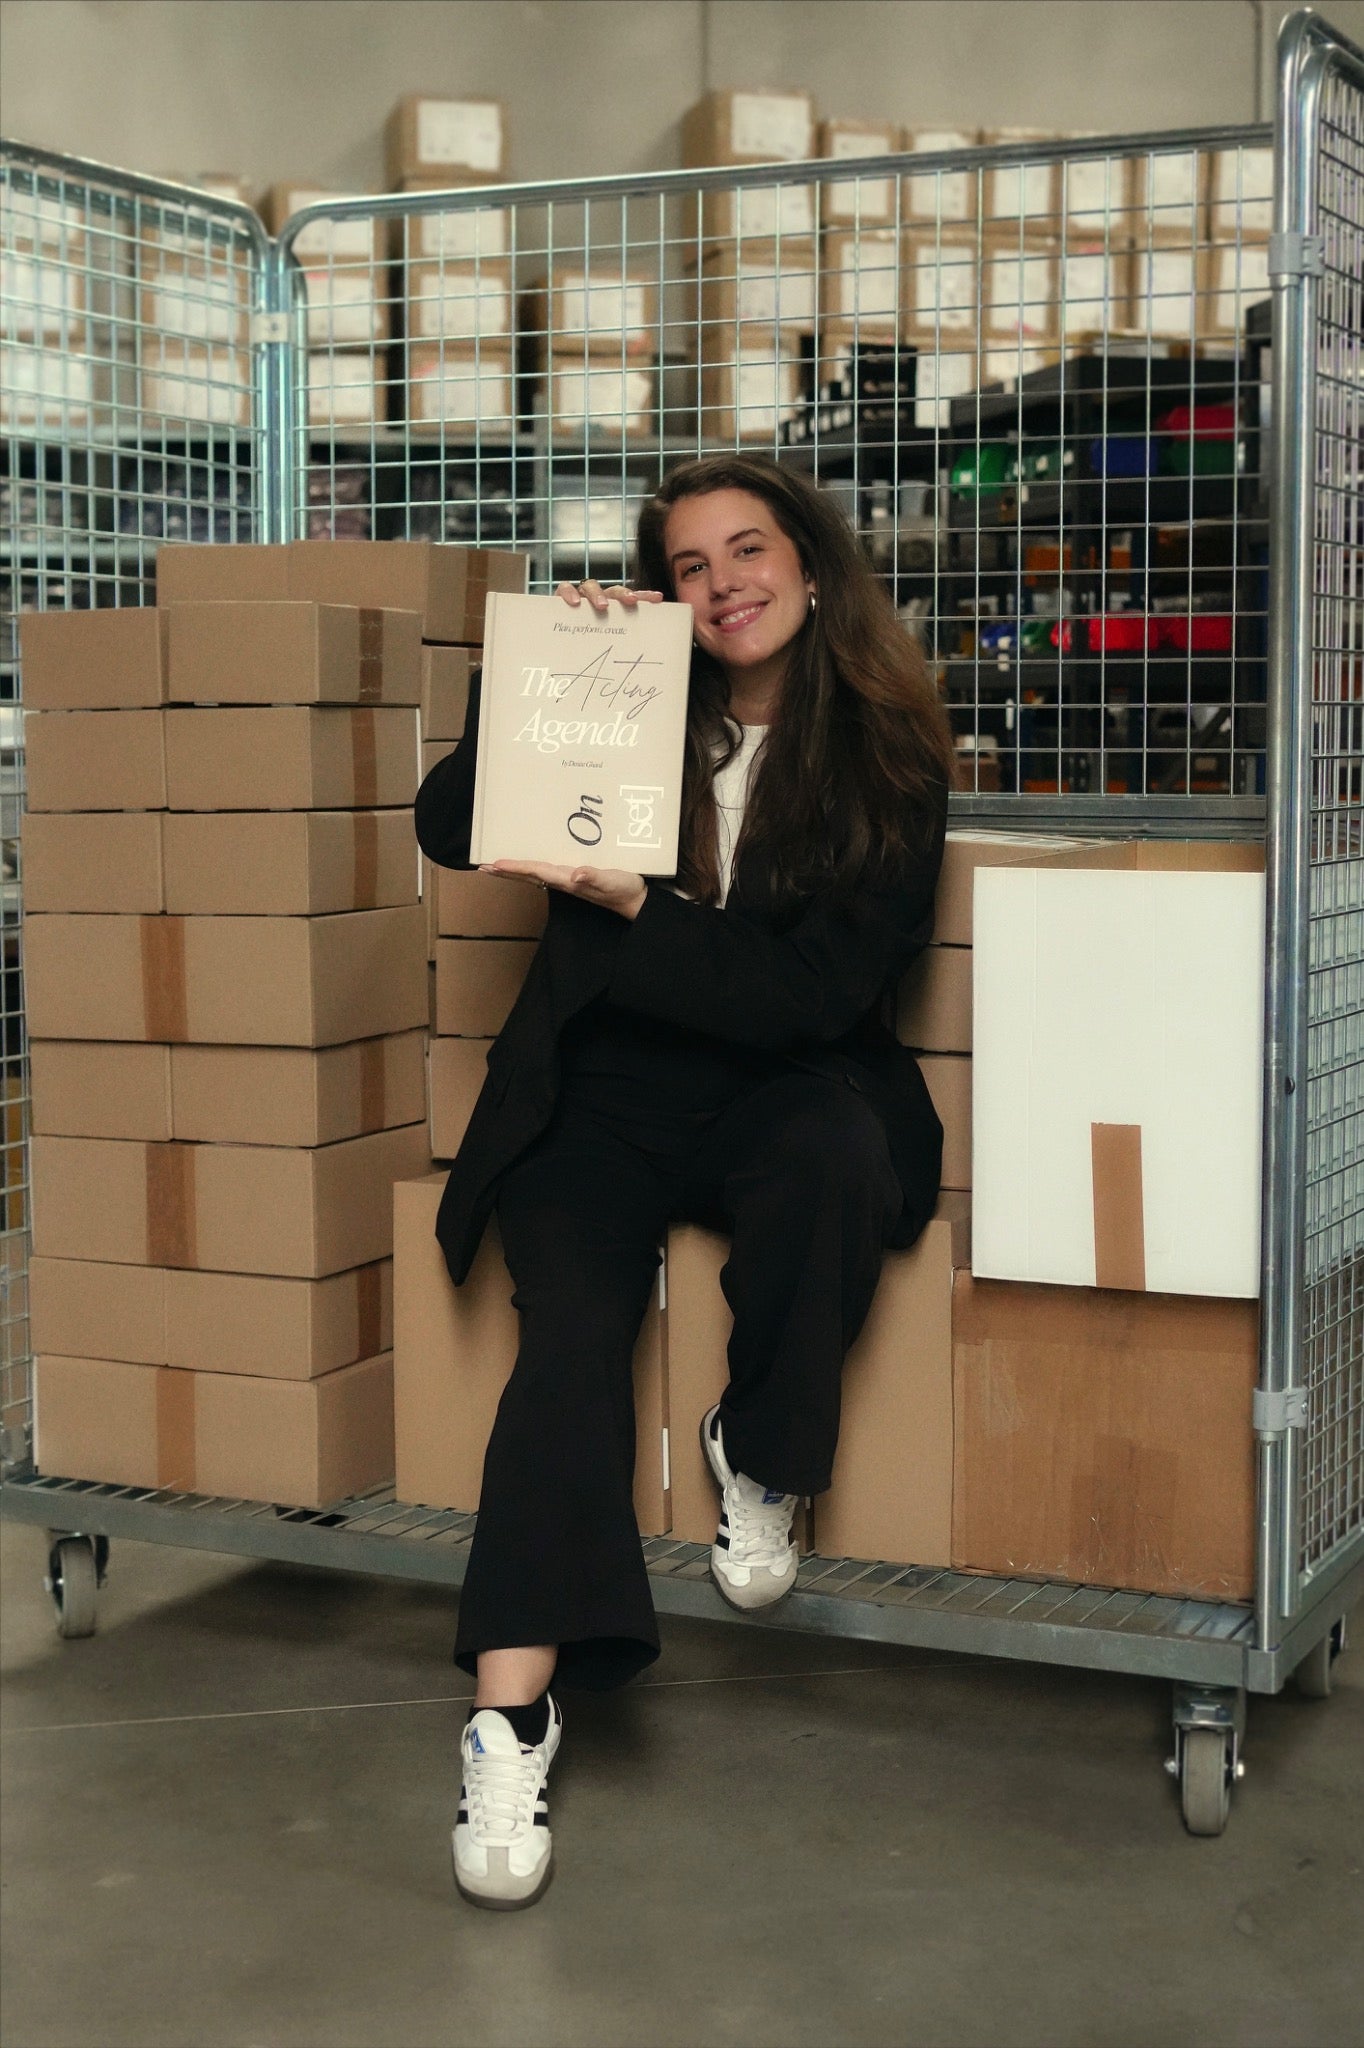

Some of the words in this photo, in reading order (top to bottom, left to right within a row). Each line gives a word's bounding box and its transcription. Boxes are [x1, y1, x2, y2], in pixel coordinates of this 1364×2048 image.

[519, 667, 571, 698] The
[550, 645, 664, 720] Acting
[513, 708, 640, 753] Agenda
[567, 794, 603, 846] On
